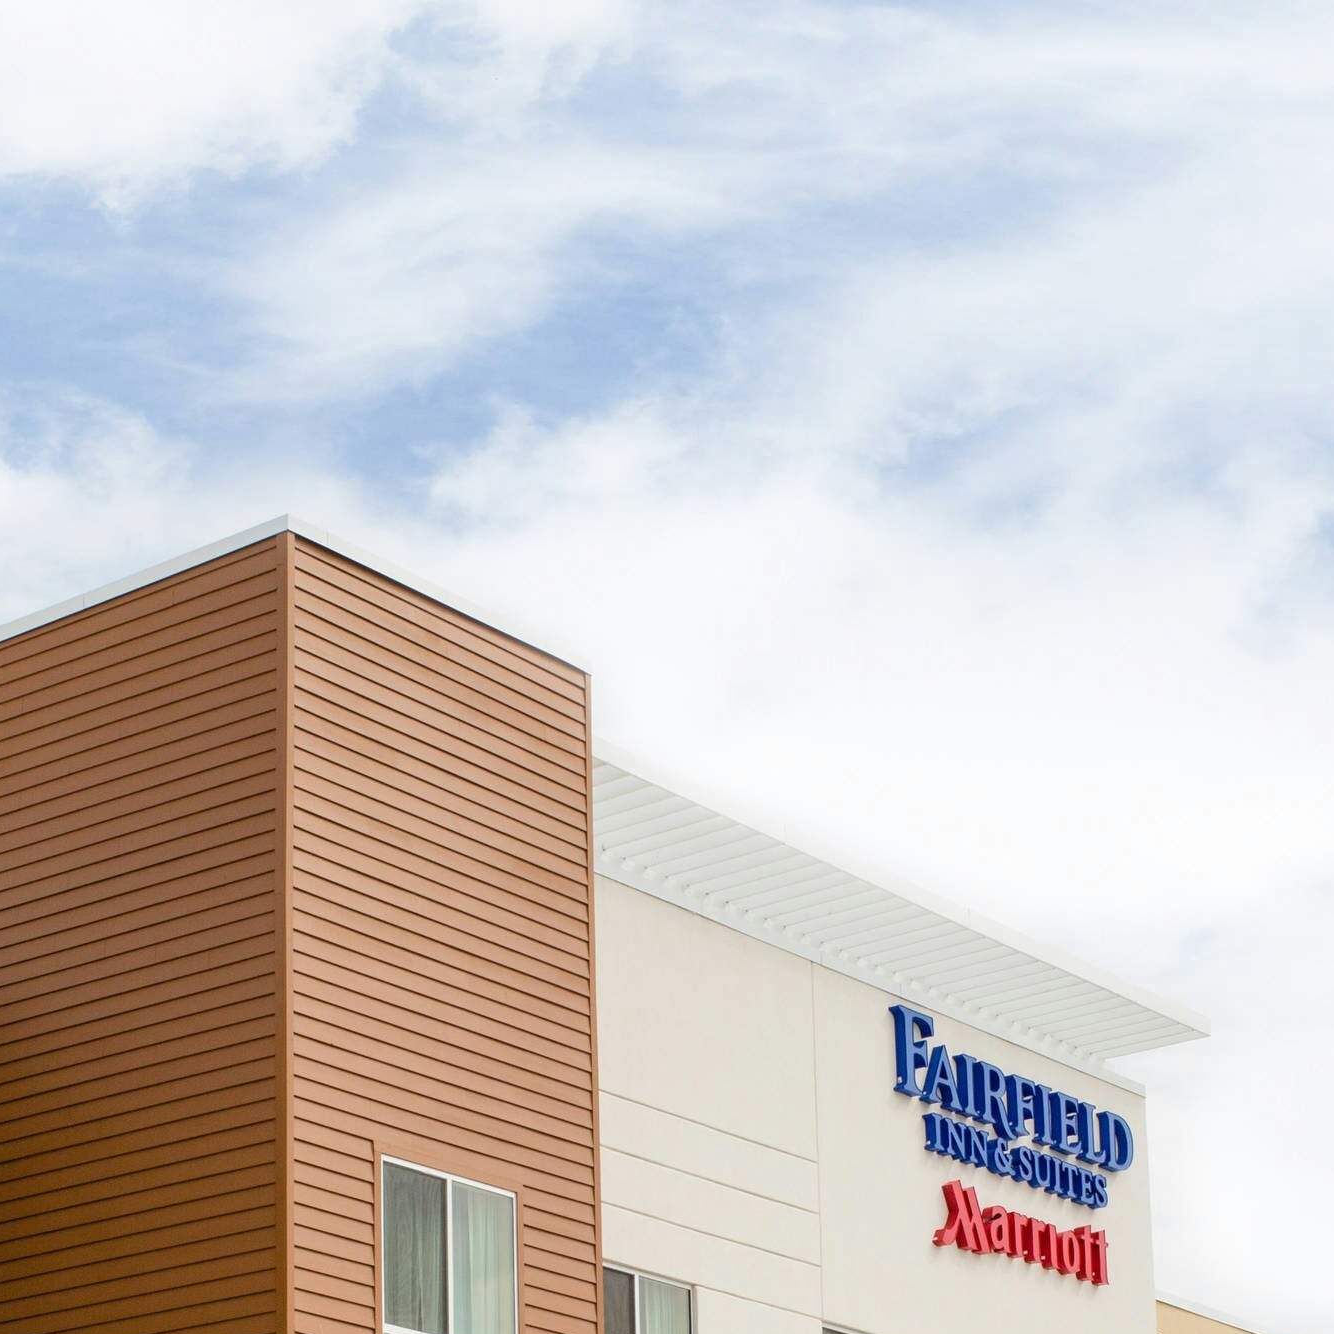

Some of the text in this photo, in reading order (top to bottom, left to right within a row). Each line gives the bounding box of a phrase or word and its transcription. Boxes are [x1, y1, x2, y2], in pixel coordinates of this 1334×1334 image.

[888, 1004, 1134, 1172] FAIRFIELD
[922, 1112, 990, 1168] INN
[1011, 1145, 1108, 1209] SUITES
[932, 1179, 1109, 1286] Marriott
